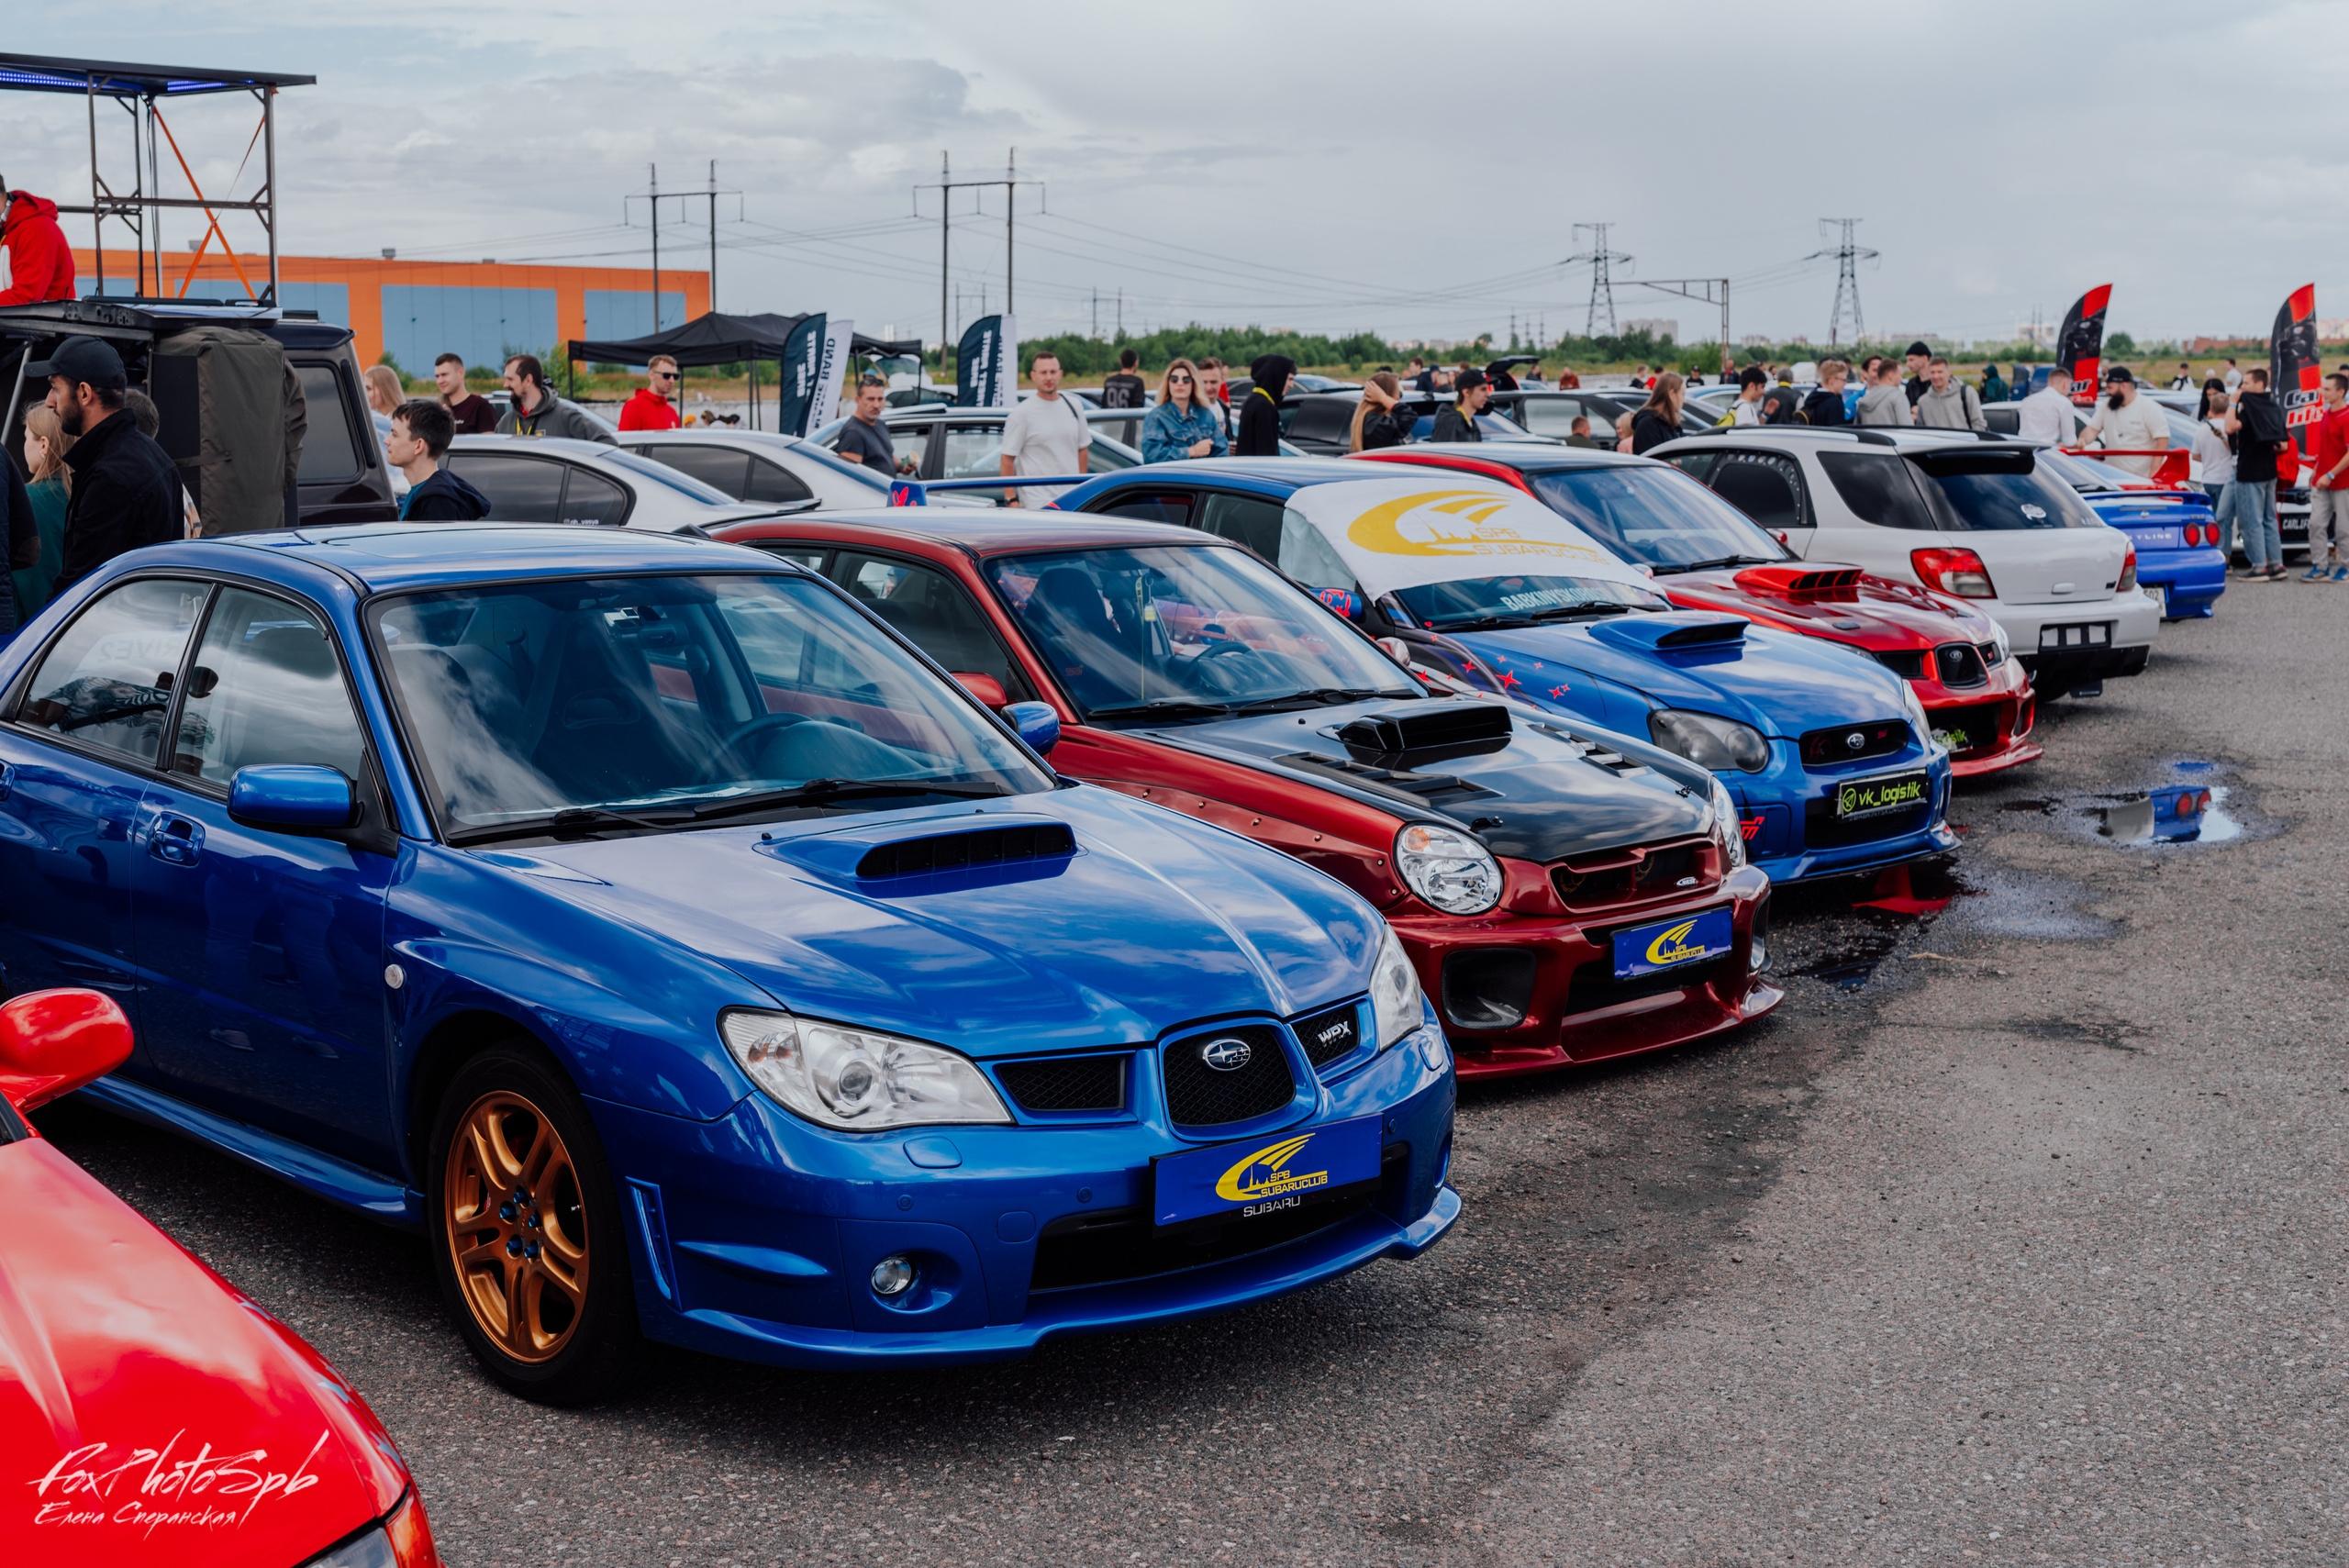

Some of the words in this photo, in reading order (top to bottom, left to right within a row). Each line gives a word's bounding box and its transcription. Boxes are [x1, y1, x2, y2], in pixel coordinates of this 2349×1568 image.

[1475, 527, 1520, 539] SPB
[1859, 781, 1920, 806] vk_logistik
[1317, 1020, 1353, 1048] WRX
[1261, 1175, 1328, 1197] SUBARUCLUB
[1270, 1170, 1290, 1182] SPB
[1243, 1195, 1300, 1218] SUBARU
